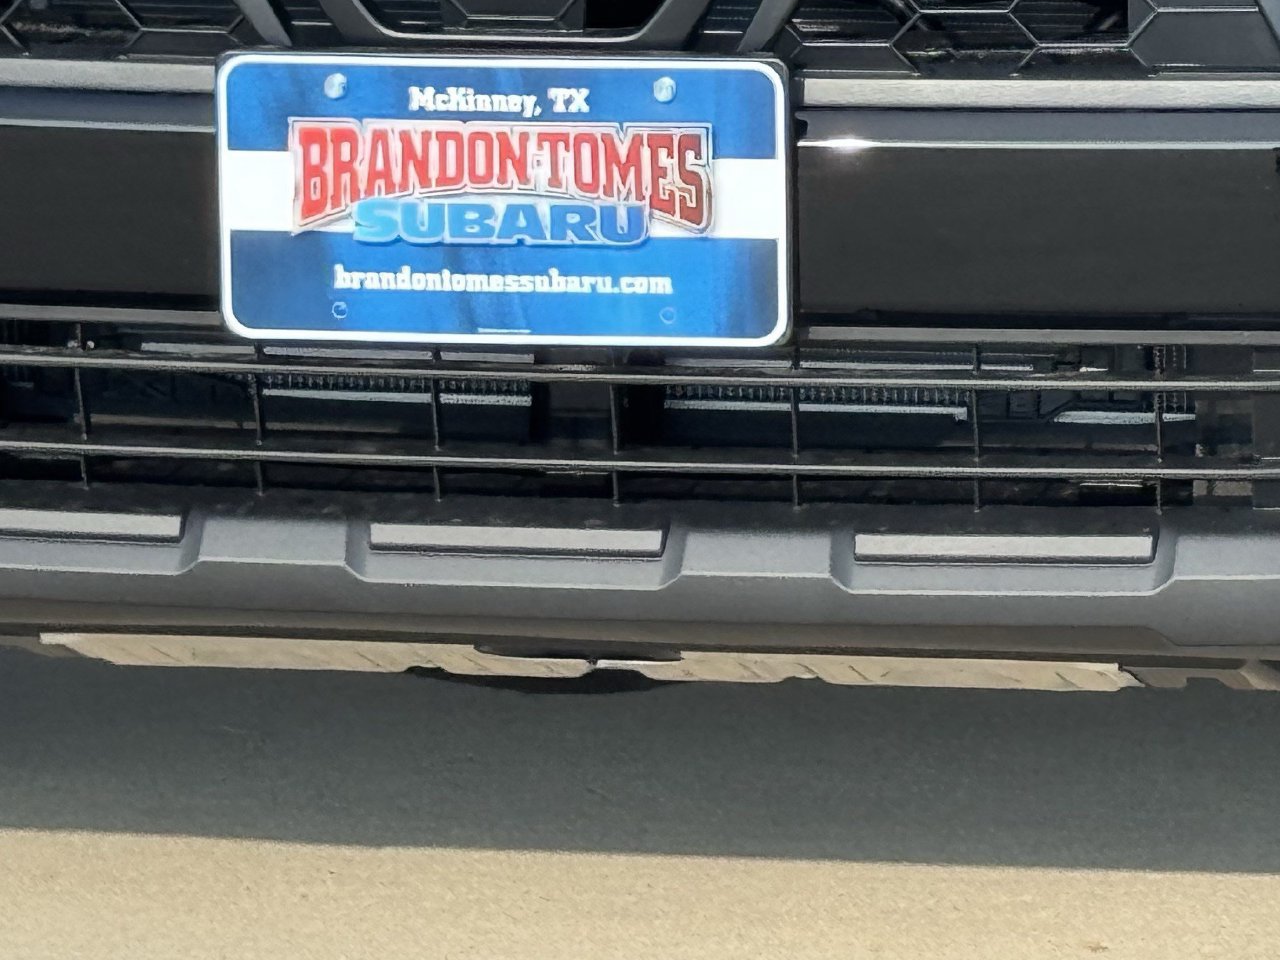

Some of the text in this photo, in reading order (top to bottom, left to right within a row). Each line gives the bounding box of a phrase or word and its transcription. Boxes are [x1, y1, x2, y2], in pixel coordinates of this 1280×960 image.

[547, 88, 591, 113] TX
[299, 126, 709, 229] BRANDON TOMES
[354, 198, 648, 245] SUBARU
[333, 264, 674, 295] brandontomessubaru.com
